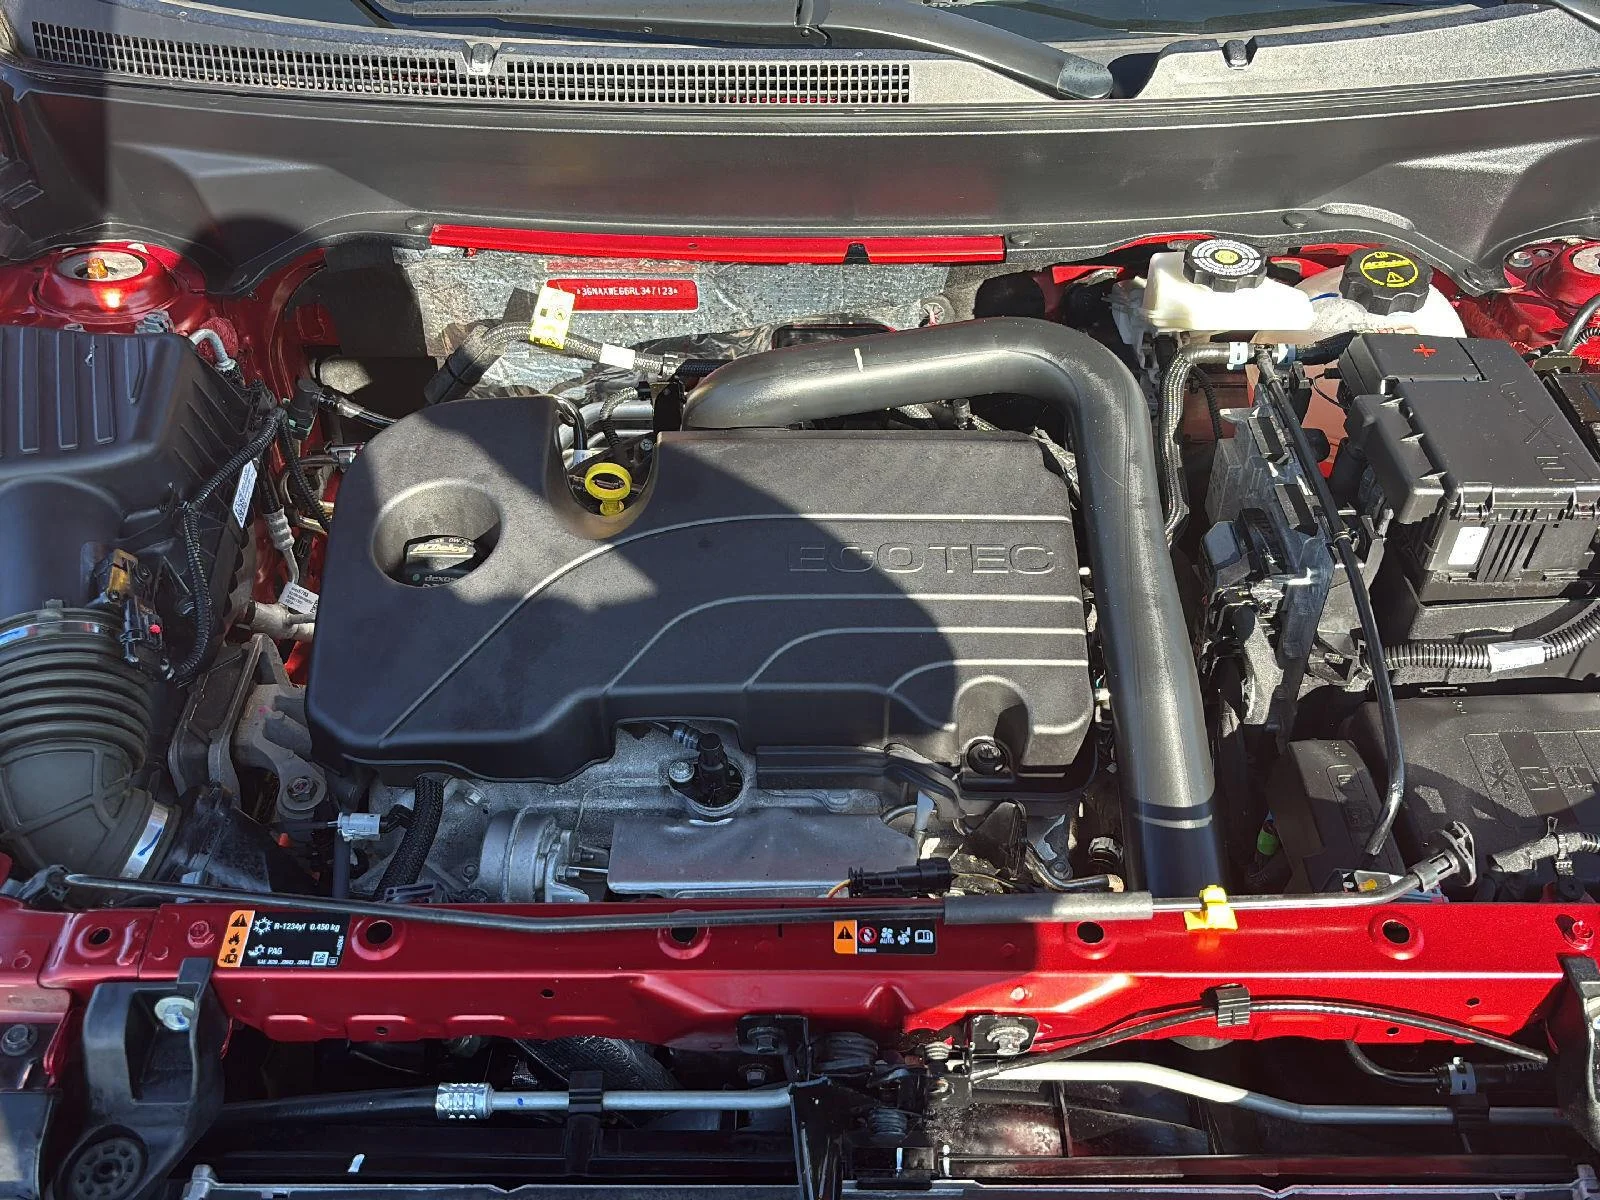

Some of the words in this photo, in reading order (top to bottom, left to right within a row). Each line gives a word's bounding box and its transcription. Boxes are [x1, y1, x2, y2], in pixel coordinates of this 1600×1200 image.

[787, 542, 1056, 575] ECOTEC
[274, 922, 306, 931] R-1234yf
[330, 924, 340, 932] kg
